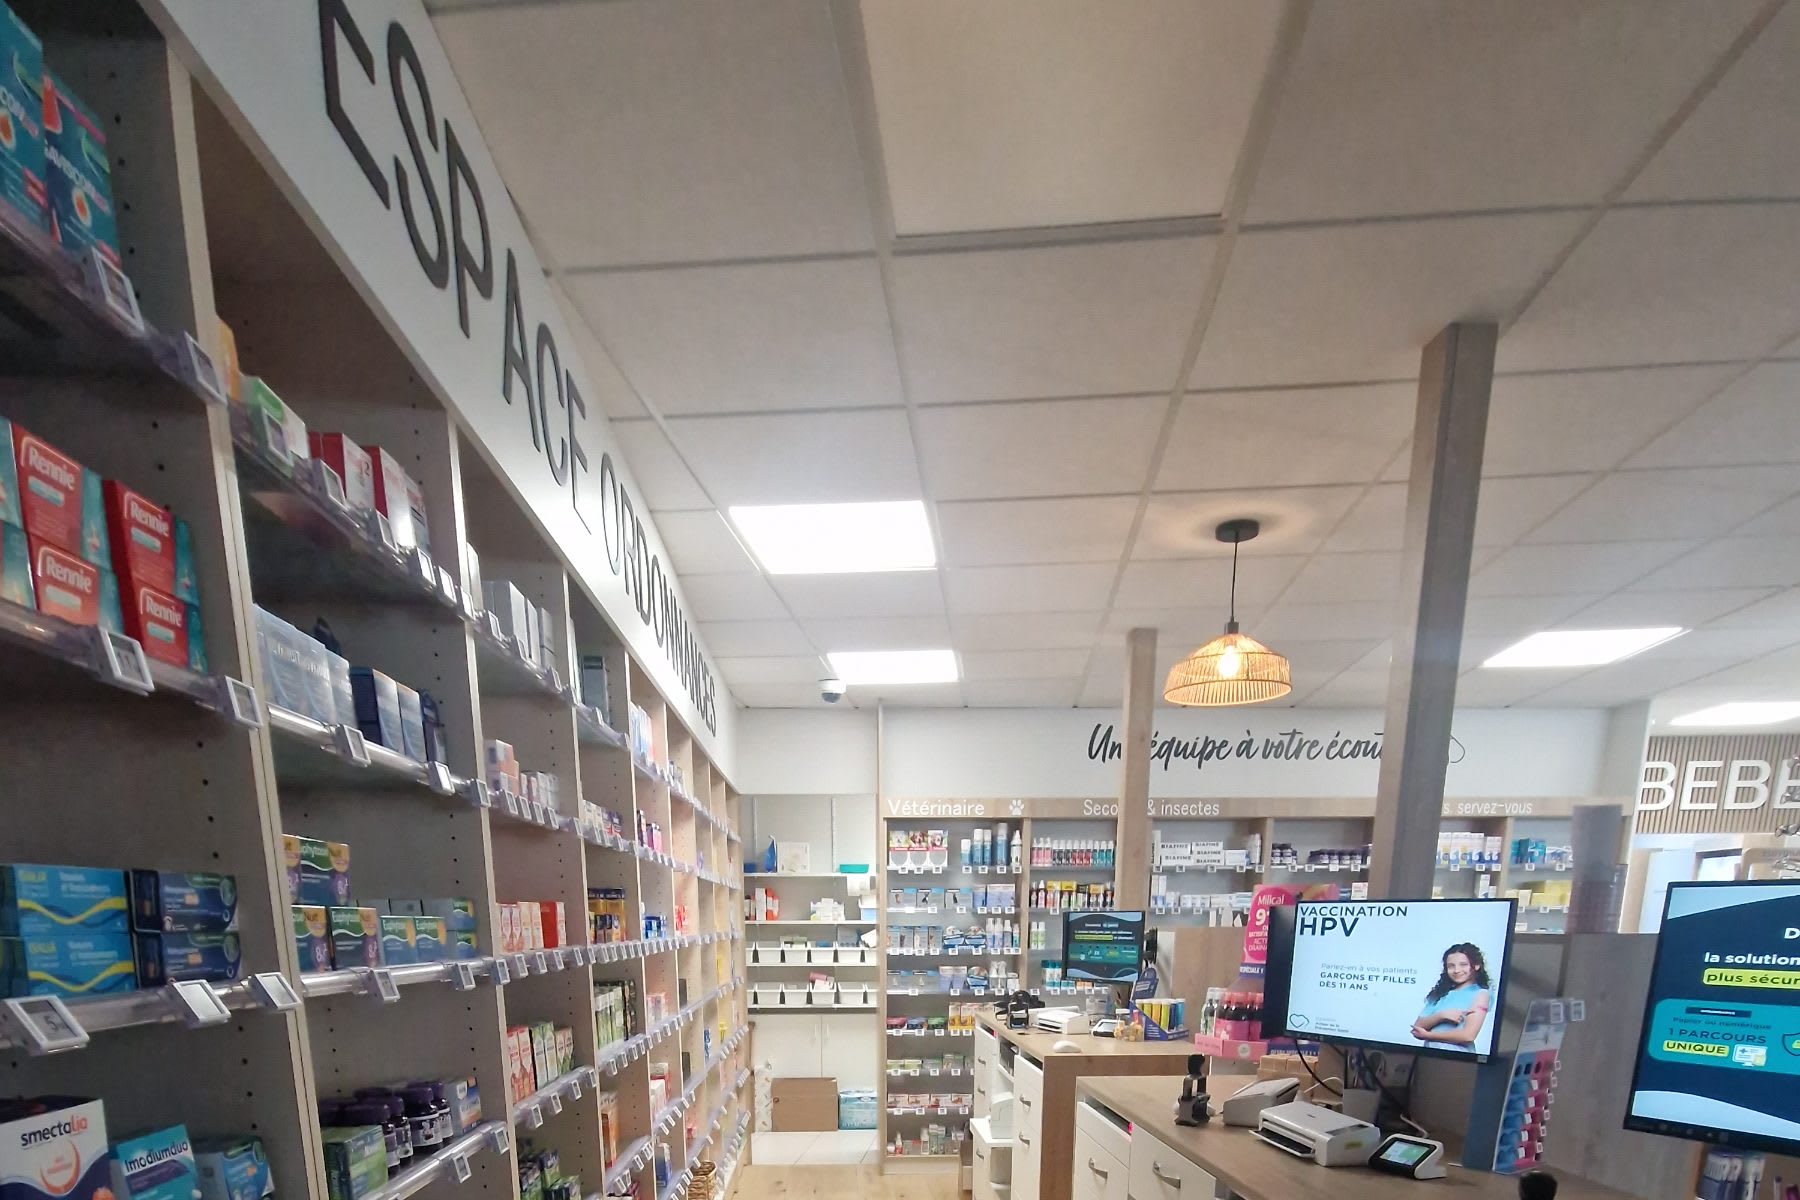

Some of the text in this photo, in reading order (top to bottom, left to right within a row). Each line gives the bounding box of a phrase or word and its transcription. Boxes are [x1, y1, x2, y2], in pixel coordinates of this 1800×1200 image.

[29, 448, 75, 490] Rennie
[130, 502, 169, 537] Rennie
[46, 554, 92, 594] Rennie
[601, 452, 716, 737] ORDONNANCES
[146, 595, 182, 628] Rennie
[1087, 723, 1384, 770] Un équipe à votre écou
[888, 799, 985, 816] Vétérinaire
[1083, 799, 1118, 816] Seco
[1161, 800, 1220, 816] insectes
[1457, 801, 1533, 815] servez-vous
[1258, 894, 1285, 906] Milical
[1300, 905, 1408, 917] VACCINATION
[1299, 917, 1360, 938] HPV
[1704, 951, 1800, 966] la solution
[1320, 971, 1365, 981] GARÇONS
[1383, 976, 1416, 985] FILLES
[1382, 967, 1418, 976] patients
[1706, 972, 1743, 983] plus
[1319, 980, 1336, 989] DÈS
[1350, 983, 1369, 991] ANS
[1668, 1027, 1767, 1044] 1 PARCOURS
[1666, 1041, 1727, 1055] UNIQUE
[21, 1113, 88, 1147] smectalia
[125, 1141, 189, 1173] Imodiumduo
